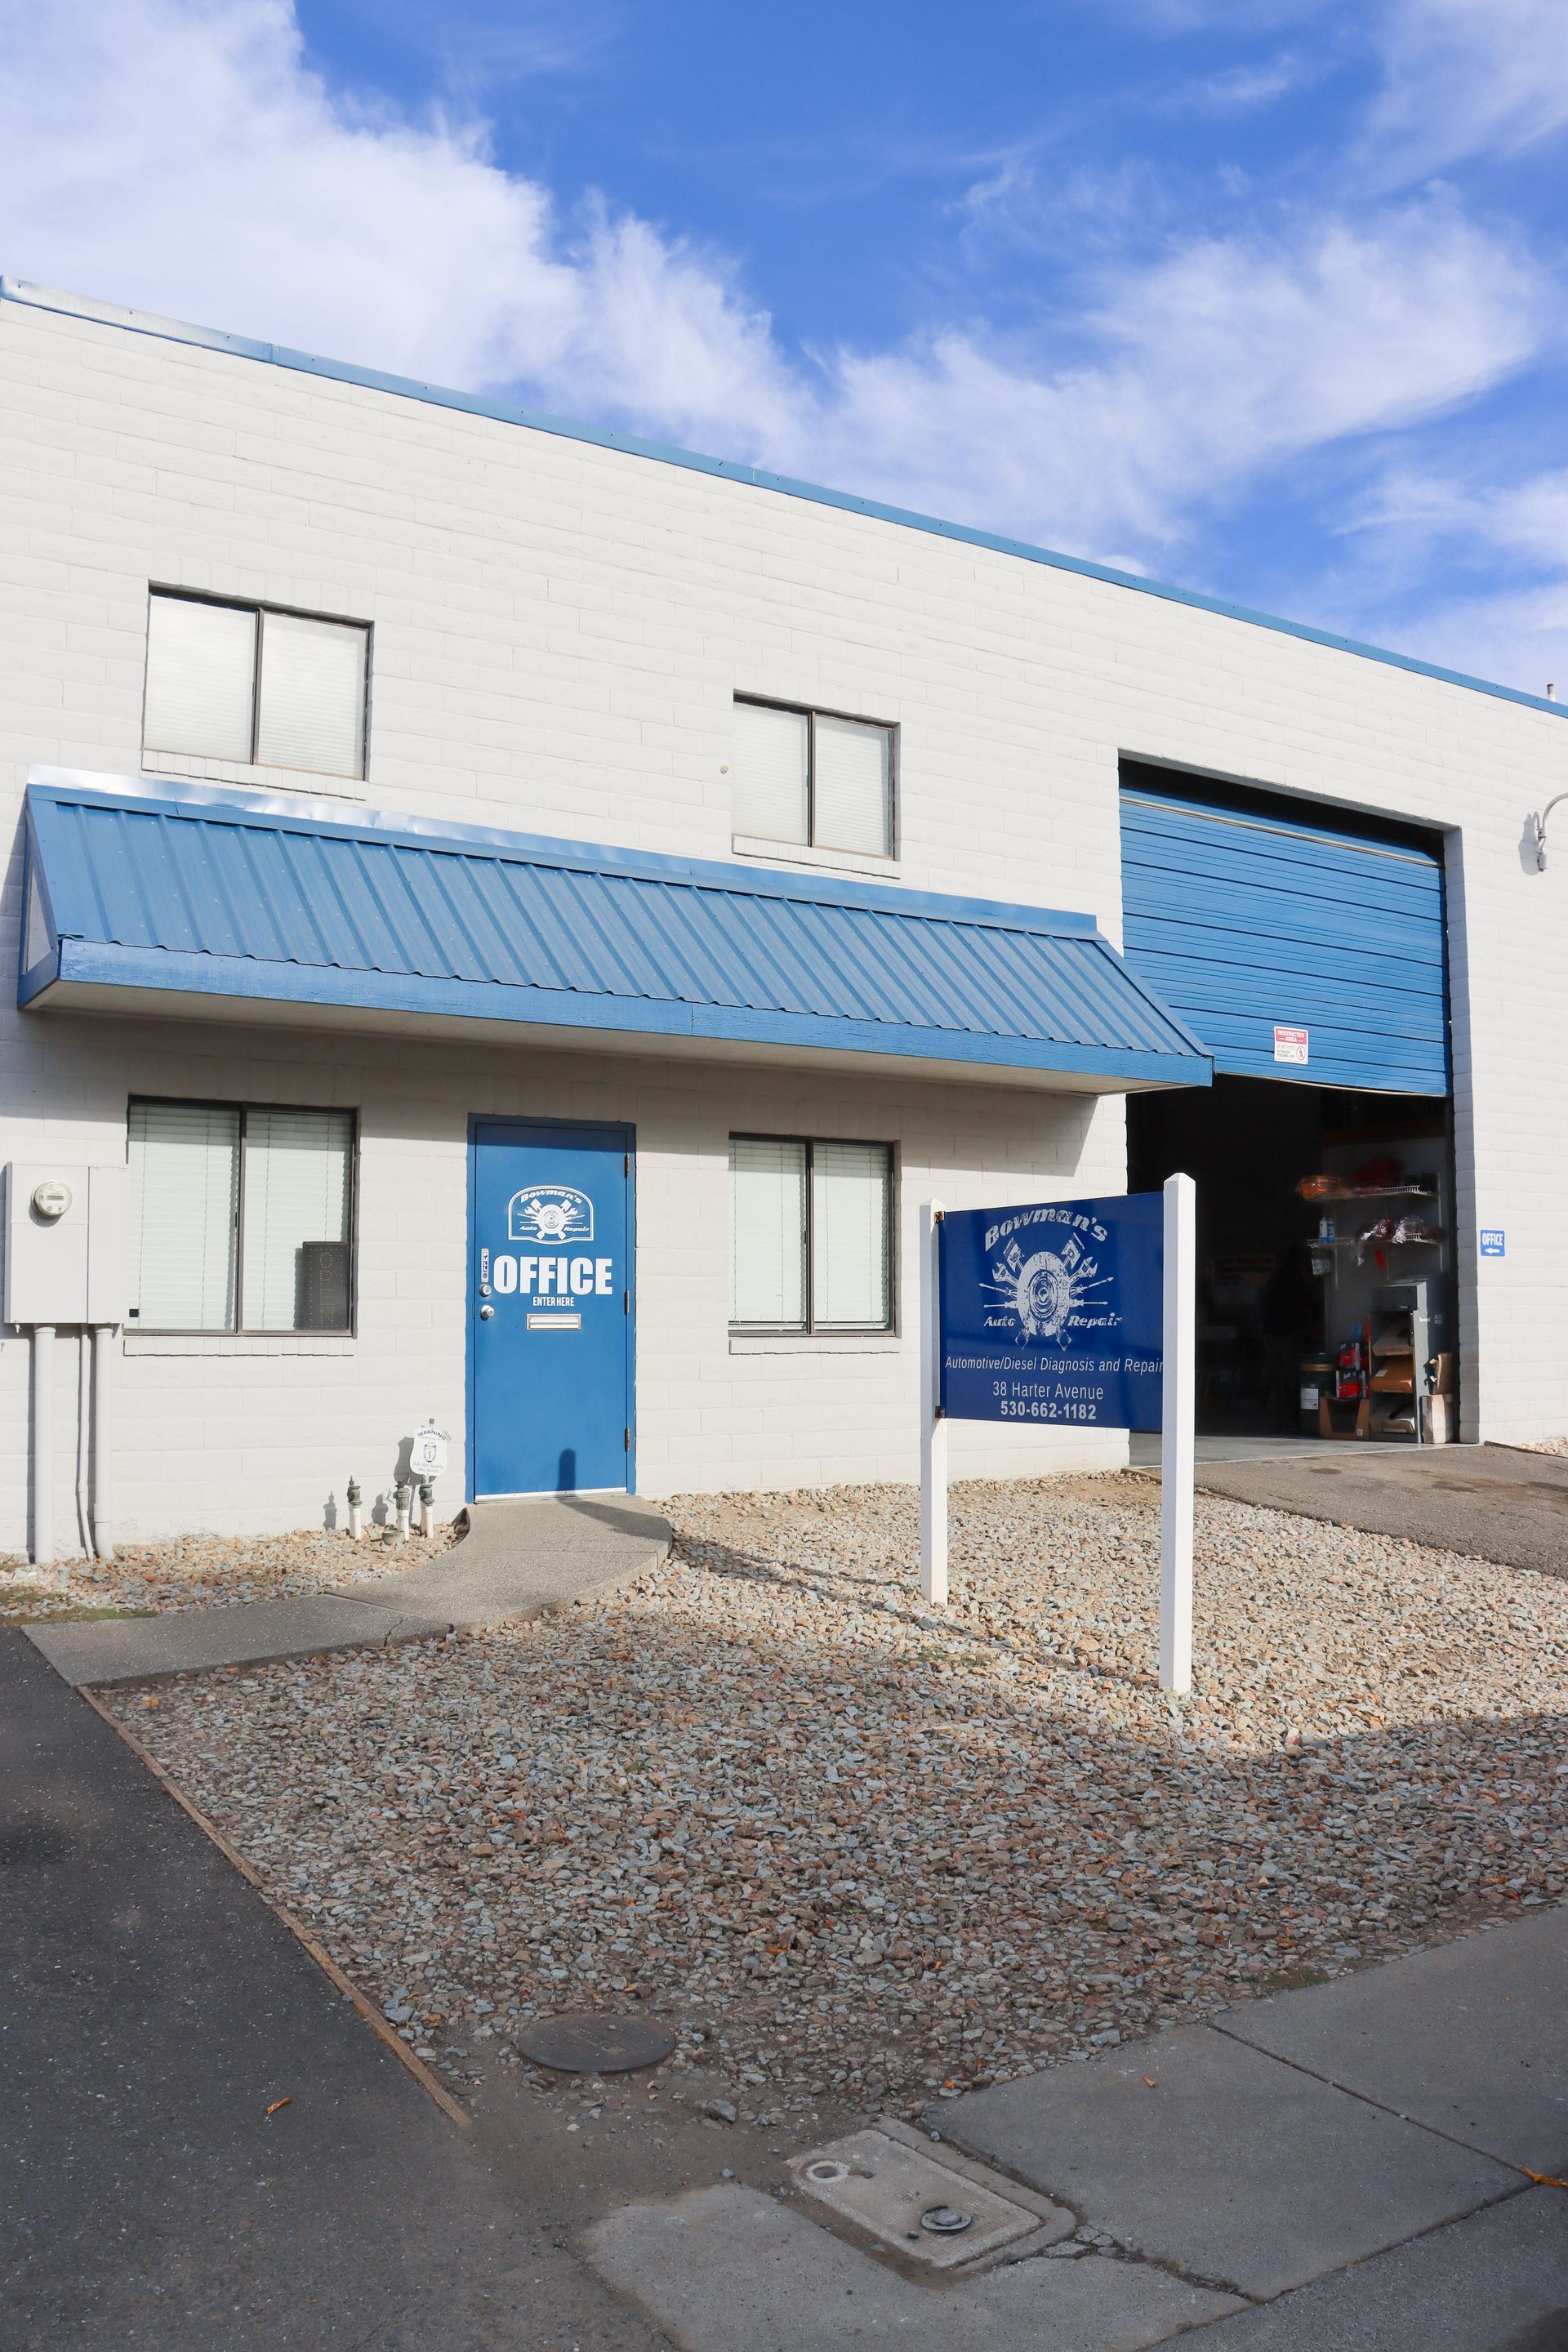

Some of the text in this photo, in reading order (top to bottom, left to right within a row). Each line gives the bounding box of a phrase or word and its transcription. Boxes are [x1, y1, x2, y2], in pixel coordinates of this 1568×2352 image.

[520, 1189, 583, 1205] Bowman's
[985, 1208, 1108, 1252] Bowman's
[1482, 1232, 1503, 1246] OFFICE
[493, 1254, 612, 1295] OFFICE
[532, 1296, 575, 1307] ENTER HERE
[983, 1312, 1123, 1329] Auto Repair
[945, 1356, 1163, 1376] Automotive/Diesel Diagnosis and Repair
[992, 1381, 1103, 1400] 38 Harter Avenue
[1000, 1401, 1097, 1420] 530-662-1182
[417, 1430, 447, 1441] WARNING
